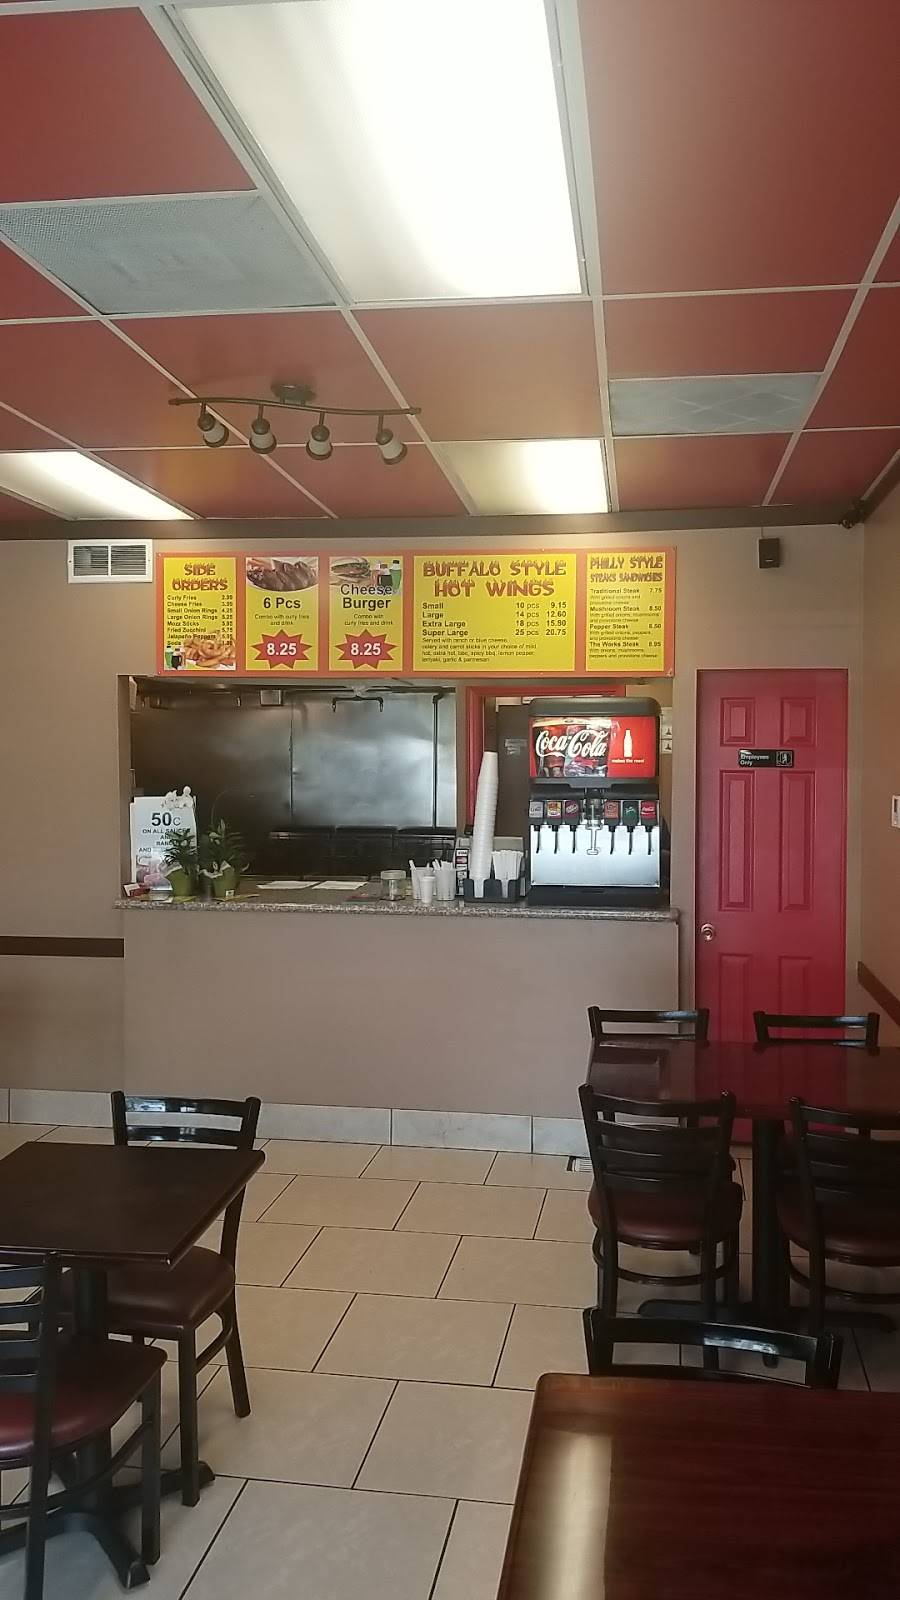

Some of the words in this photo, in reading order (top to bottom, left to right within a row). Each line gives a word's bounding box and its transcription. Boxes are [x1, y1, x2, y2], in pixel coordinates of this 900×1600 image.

[423, 560, 501, 577] BUFFALO
[509, 559, 567, 576] STYLE
[590, 556, 624, 569] PHILLY
[629, 555, 663, 569] STYLE
[184, 563, 216, 576] SIDE
[172, 577, 228, 591] ORDERS
[590, 573, 617, 583] STEAKS
[340, 583, 392, 595] Cheese
[434, 578, 475, 597] HOT
[485, 577, 555, 597] WINGS
[263, 597, 272, 609] 6
[275, 597, 301, 609] Pcs
[342, 597, 391, 611] Burger
[422, 602, 444, 610] Small
[550, 601, 567, 609] 9.15
[422, 611, 444, 620] Large
[526, 612, 540, 620] pcs
[546, 610, 567, 618] 12.60
[422, 620, 442, 628] Extra
[444, 620, 466, 629] Large
[422, 629, 445, 637] Super
[446, 629, 469, 638] Large
[515, 628, 525, 636] 25
[545, 628, 567, 636] 20.75
[266, 642, 297, 656] 8.25
[350, 643, 381, 656] 8.25
[536, 730, 610, 757] Coca-Cola
